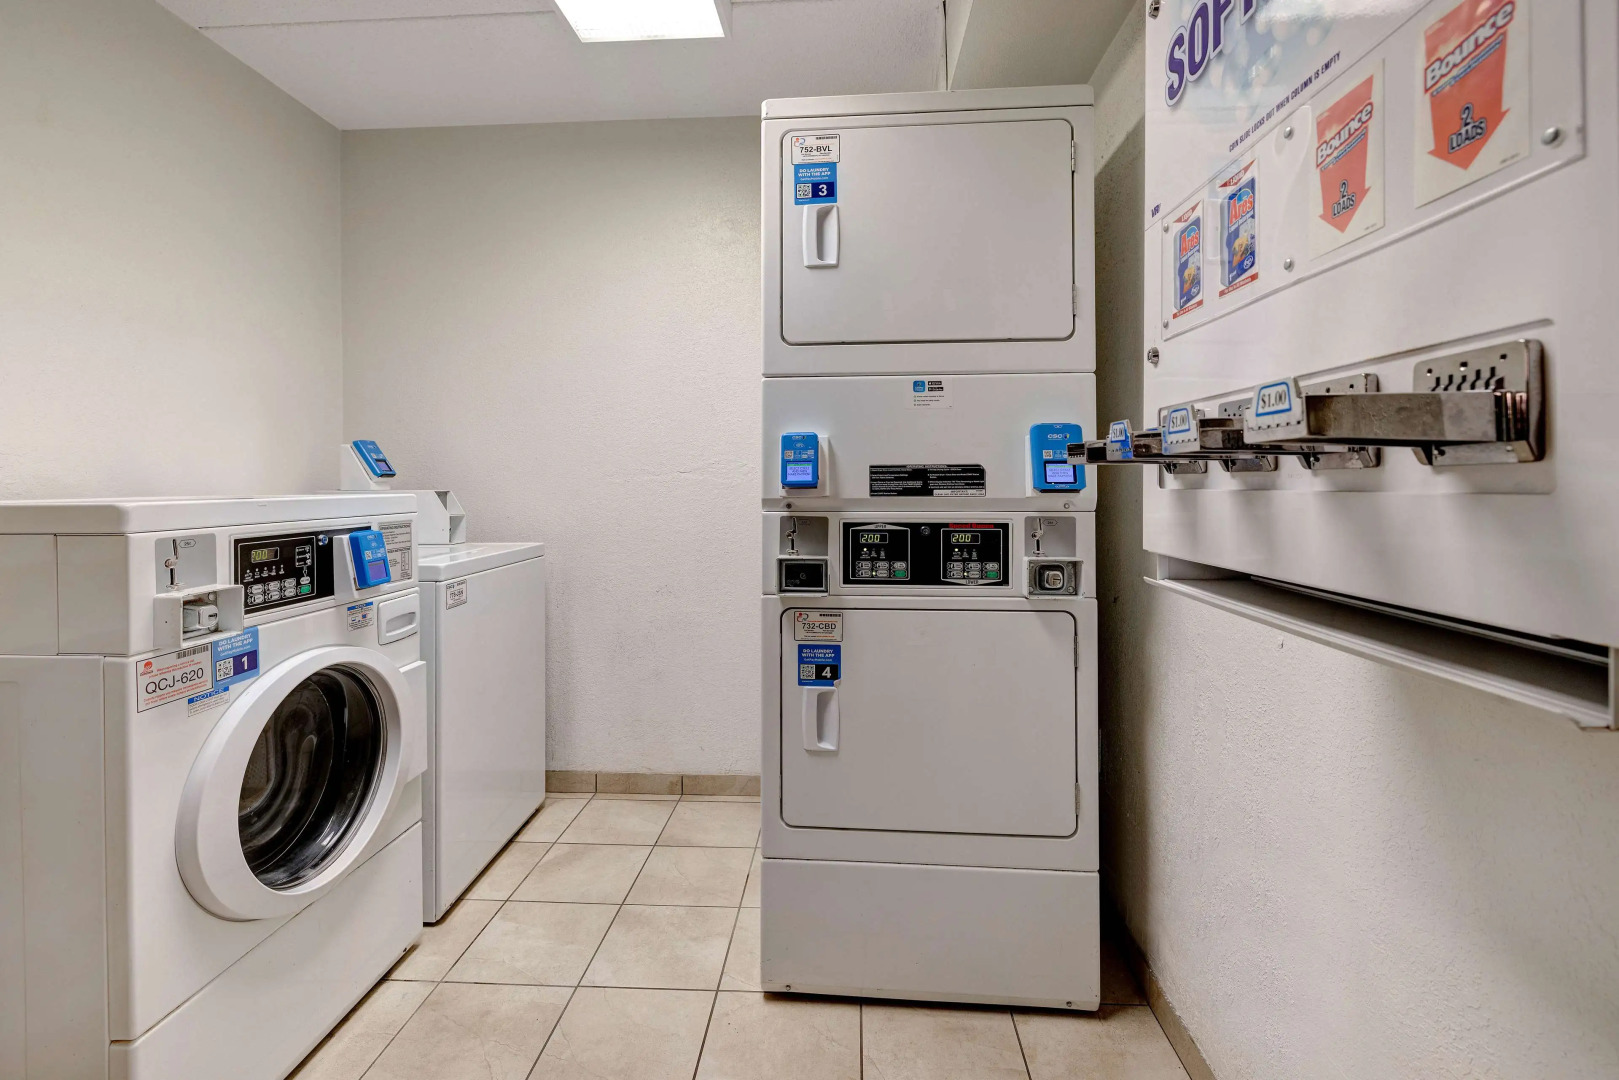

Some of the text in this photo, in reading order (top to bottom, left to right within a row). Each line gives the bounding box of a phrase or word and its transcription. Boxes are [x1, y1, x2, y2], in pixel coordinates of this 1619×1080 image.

[1425, 2, 1514, 92] Bounce
[1251, 116, 1265, 133] LOCKS
[1265, 107, 1275, 121] OUT
[1275, 95, 1290, 112] WHEN
[1291, 75, 1312, 100] COLUMN
[1313, 69, 1320, 81] IS
[1321, 51, 1341, 75] EMPTY
[1460, 102, 1474, 128] 2
[1317, 102, 1373, 167] Bounce
[1448, 118, 1487, 153] LOADS
[800, 145, 833, 154] 752-BVL
[818, 184, 828, 196] 3
[1340, 179, 1349, 199] 2
[1332, 193, 1356, 219] LOADS
[1261, 389, 1288, 410] $1.00
[1171, 414, 1188, 428] $1.00
[1112, 425, 1125, 438] $1.00
[861, 534, 880, 542] 200
[953, 534, 971, 542] 200
[802, 622, 836, 630] 732-CBD
[227, 633, 251, 644] LAUNDRY
[217, 644, 232, 652] WITH
[241, 655, 248, 670] 1
[821, 666, 832, 679] 4
[145, 667, 204, 695] QCJ-620
